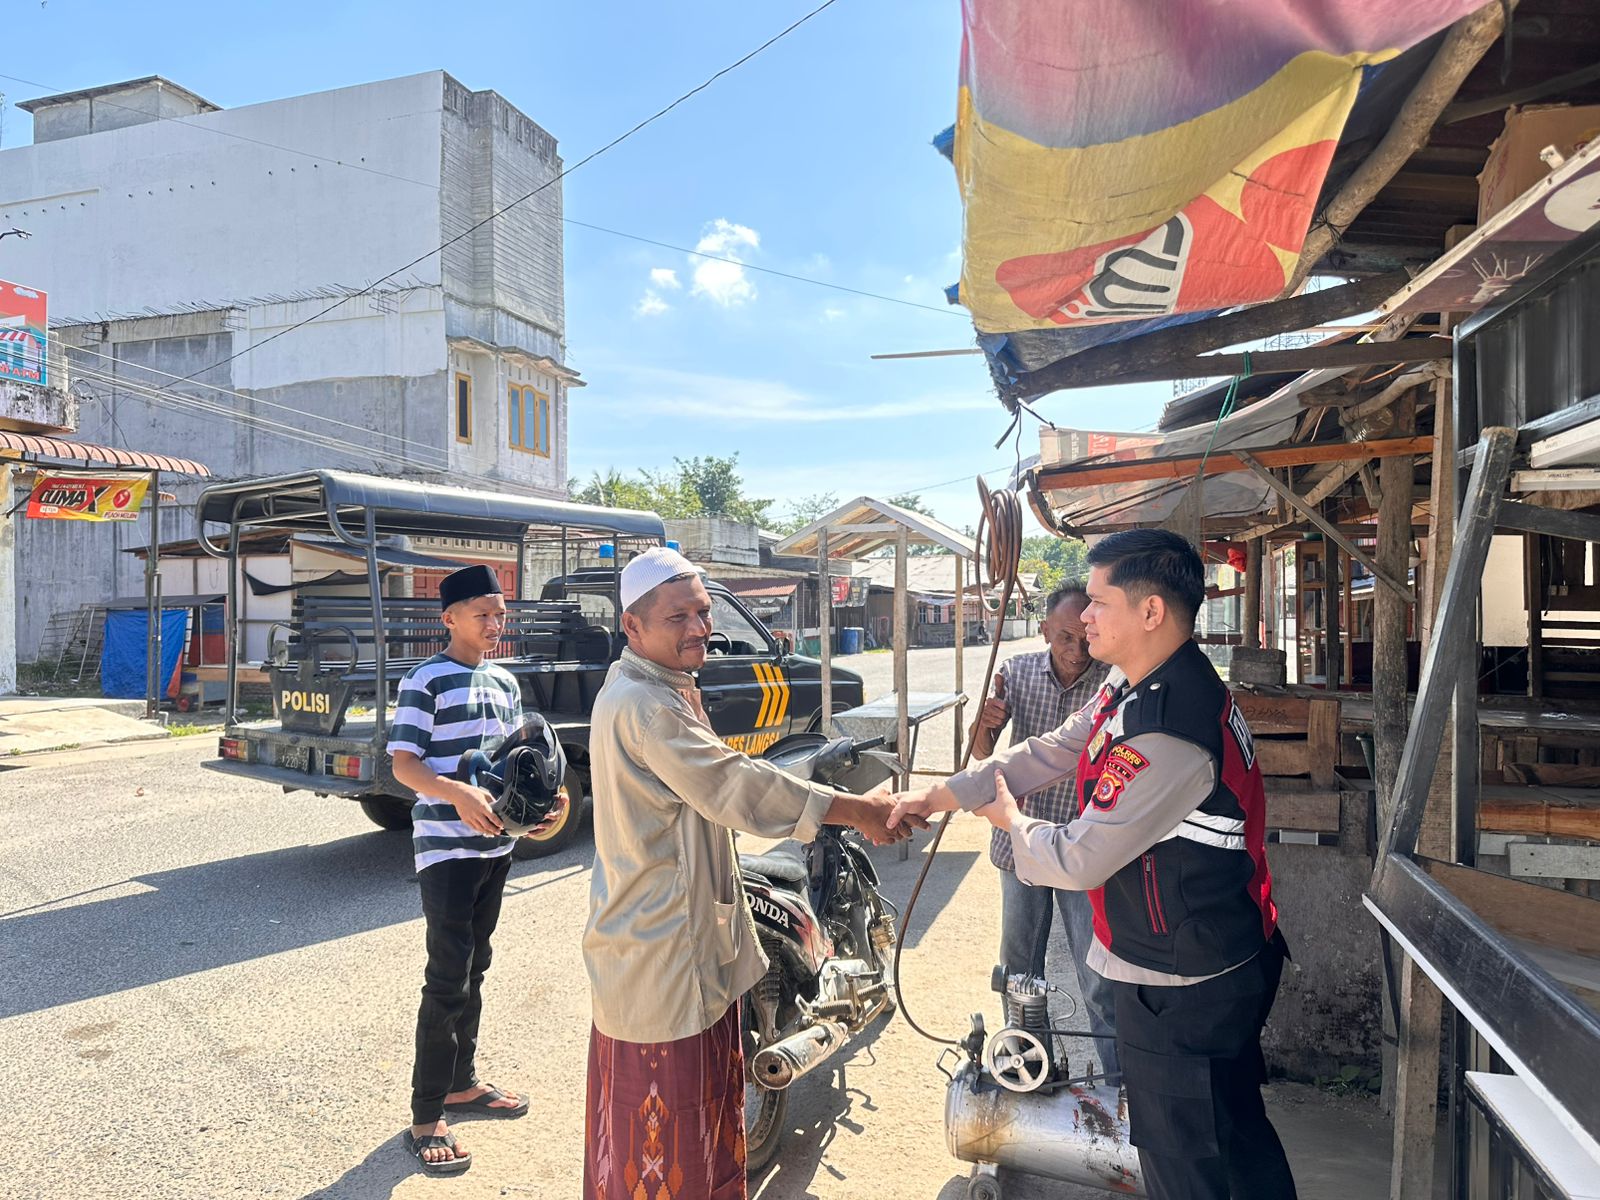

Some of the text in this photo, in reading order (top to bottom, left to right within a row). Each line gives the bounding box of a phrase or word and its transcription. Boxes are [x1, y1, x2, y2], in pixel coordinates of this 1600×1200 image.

[12, 367, 40, 381] ATM
[282, 690, 330, 714] POLISI
[1110, 745, 1142, 765] POLRES
[744, 892, 790, 929] ONDA
